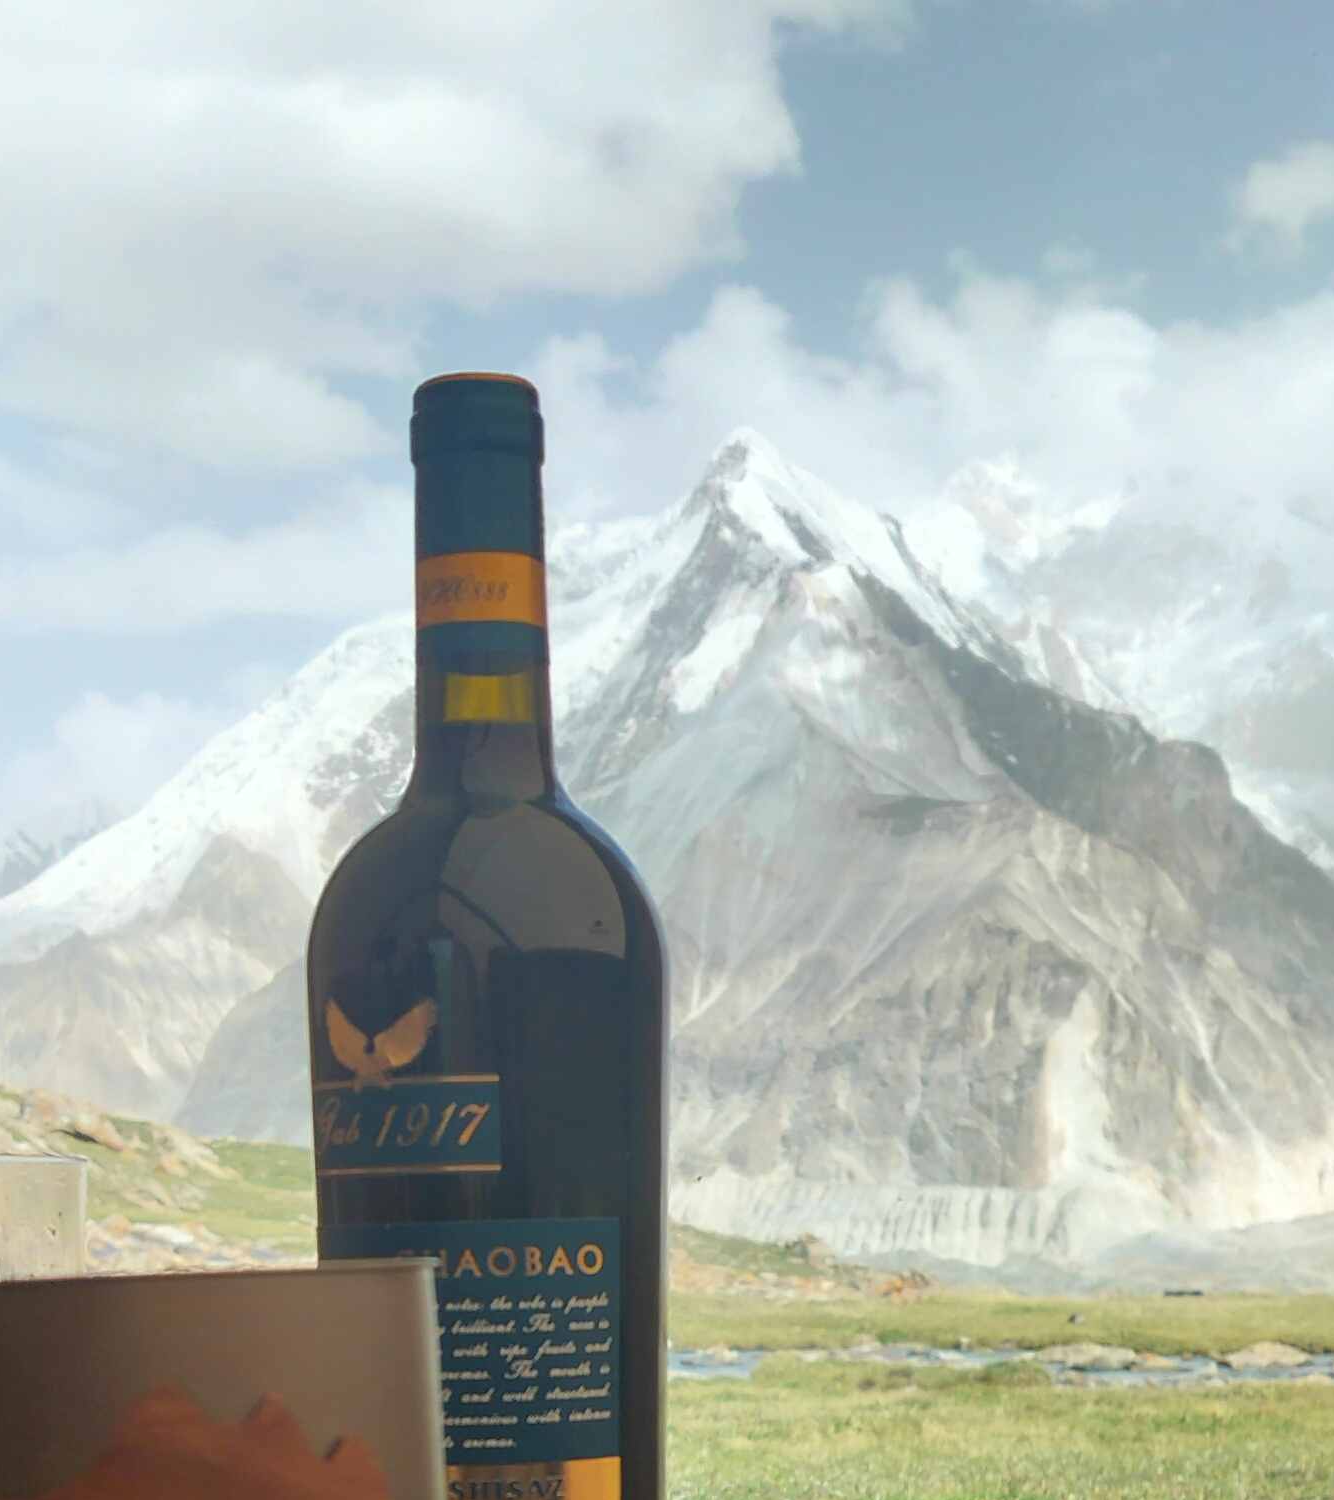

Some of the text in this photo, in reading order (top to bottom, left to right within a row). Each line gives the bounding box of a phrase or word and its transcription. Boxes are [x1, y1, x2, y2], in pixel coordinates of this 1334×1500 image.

[375, 1102, 490, 1147] 1917
[522, 1313, 556, 1333] The
[453, 1341, 489, 1358] with
[585, 1335, 613, 1354] and
[504, 1360, 540, 1379] The
[461, 1387, 496, 1403] and
[502, 1386, 540, 1403] well
[526, 1407, 562, 1425] with
